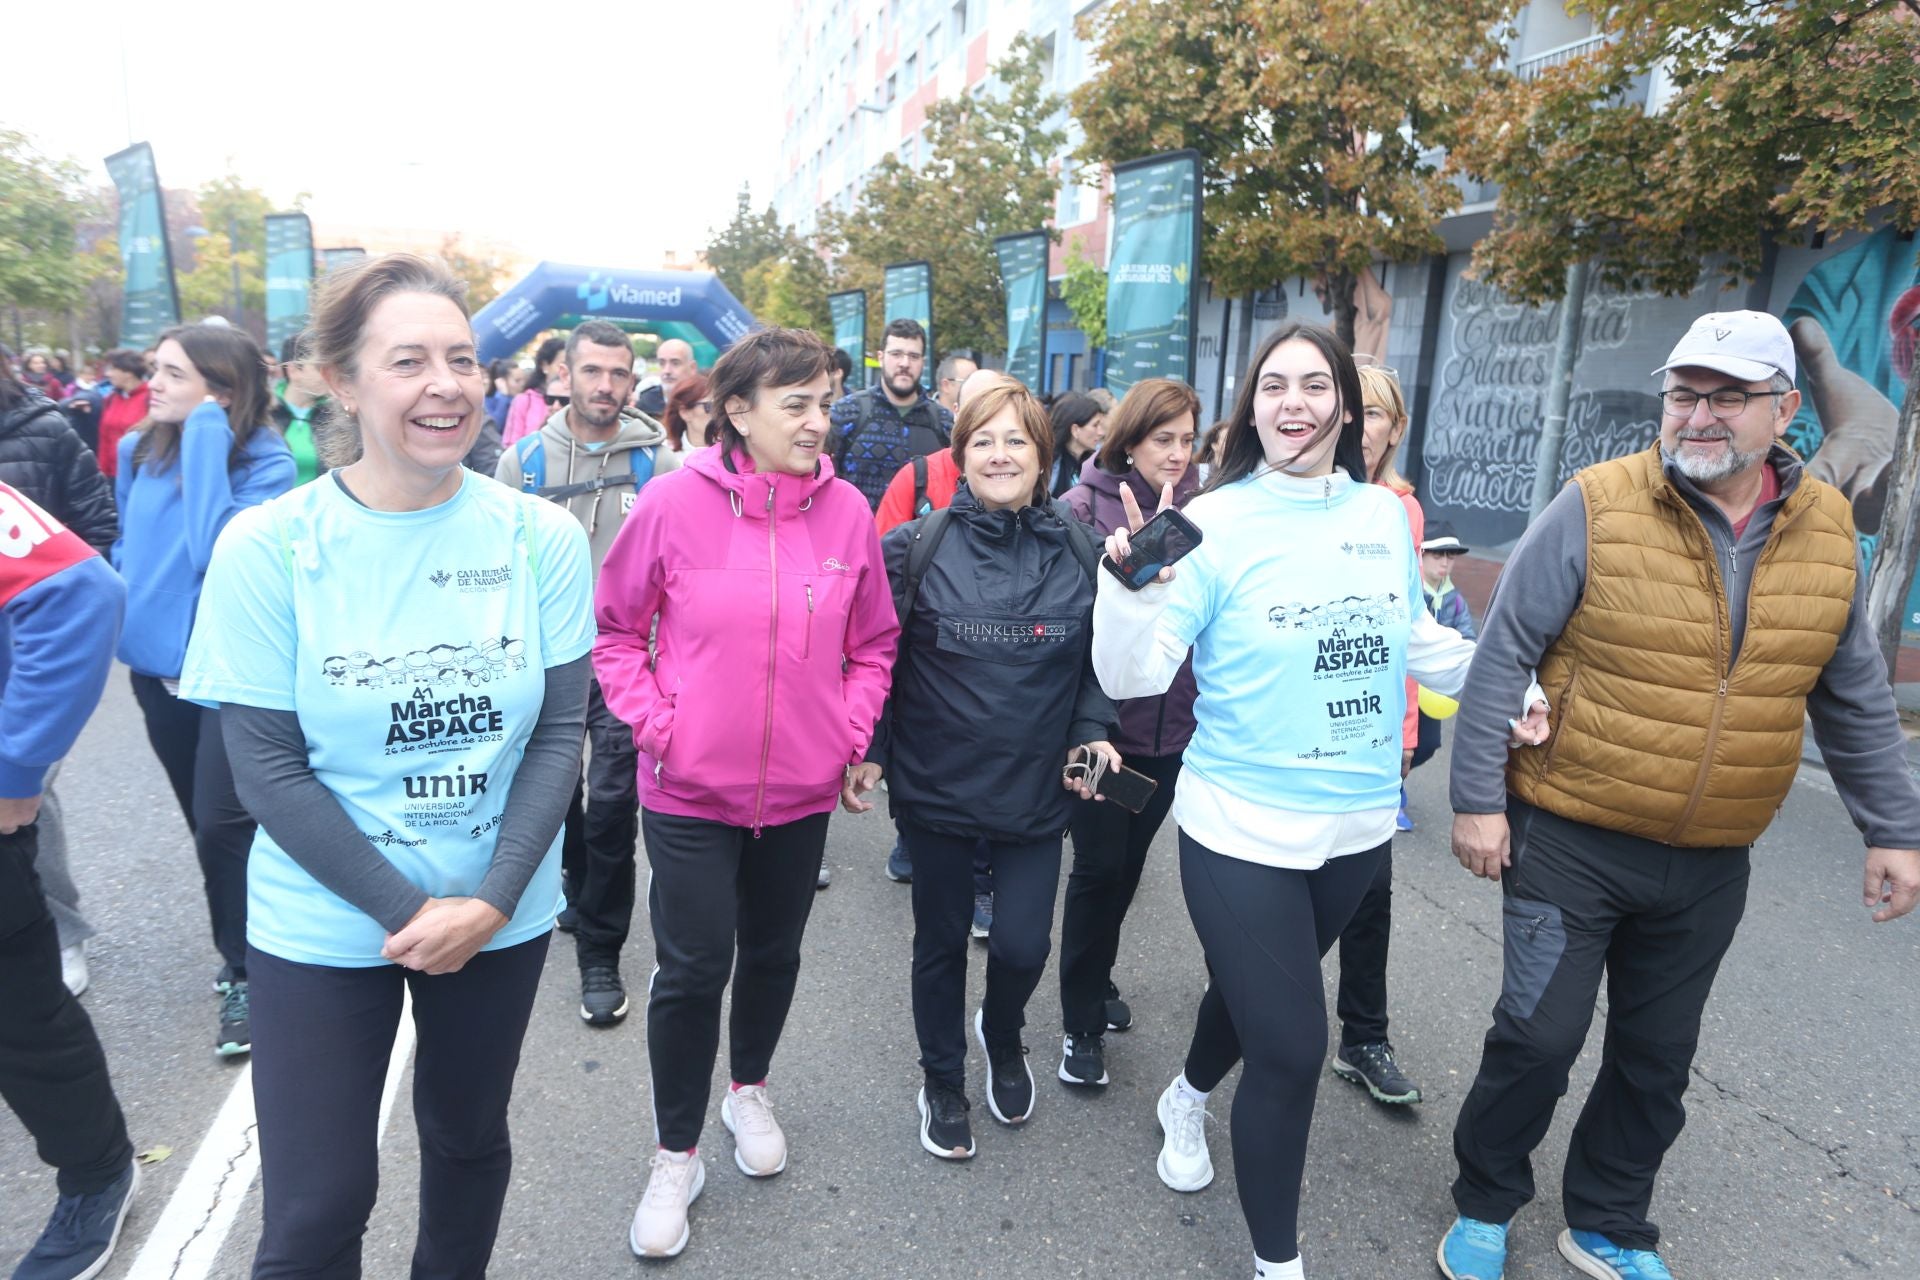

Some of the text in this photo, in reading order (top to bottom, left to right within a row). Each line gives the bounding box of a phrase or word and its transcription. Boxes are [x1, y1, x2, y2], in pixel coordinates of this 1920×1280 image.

[610, 284, 682, 307] viamed
[1445, 349, 1546, 388] Pilates
[1433, 386, 1590, 431] Nutricin
[457, 564, 512, 578] CAJA RURAL
[457, 573, 512, 586] DE NAVARR
[954, 622, 1034, 636] THINKLESS
[1332, 627, 1347, 639] 41
[956, 635, 1066, 643] EIGHTHOUSAND
[1318, 633, 1384, 654] Marcha
[1313, 647, 1390, 673] ASPACE
[1335, 670, 1362, 679] octubre
[1374, 665, 1389, 673] 2025
[412, 686, 433, 702] 41
[391, 692, 493, 723] Marcha
[385, 710, 504, 746] ASPACE
[384, 733, 504, 756] 26 de octubre de 2025
[404, 801, 465, 811] UNIVERSIDAD
[404, 819, 459, 828] DE LA RIOJA
